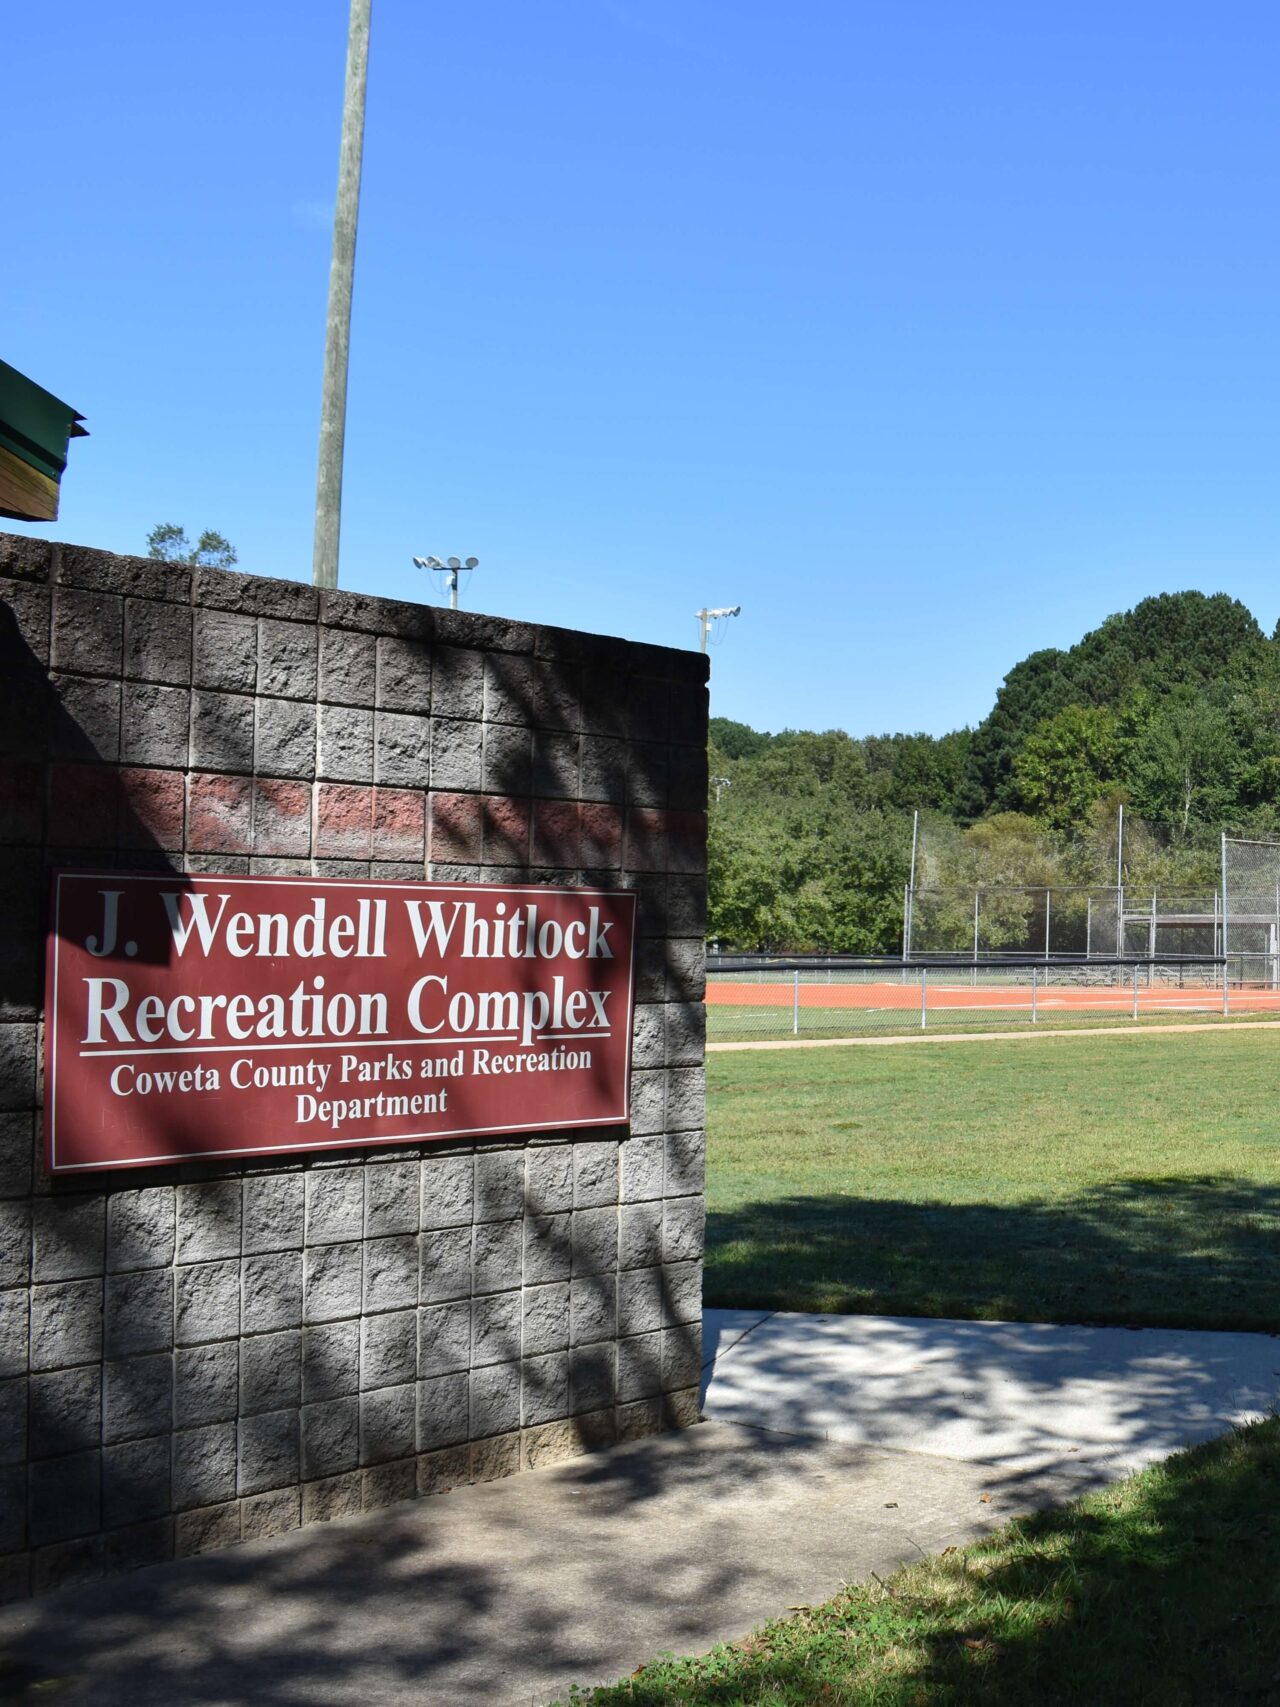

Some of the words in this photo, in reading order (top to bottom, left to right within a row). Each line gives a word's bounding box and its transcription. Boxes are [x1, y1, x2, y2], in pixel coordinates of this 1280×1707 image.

[86, 891, 138, 958] J.
[160, 892, 388, 959] Wendell
[403, 900, 615, 960] Whitlock
[81, 976, 389, 1044] Recreation
[407, 975, 613, 1047] Complex
[110, 1064, 221, 1096] Coweta
[229, 1058, 332, 1093] County
[340, 1053, 413, 1084] Parks
[420, 1049, 465, 1079] and
[471, 1045, 593, 1076] Recreation
[295, 1087, 449, 1129] Department
